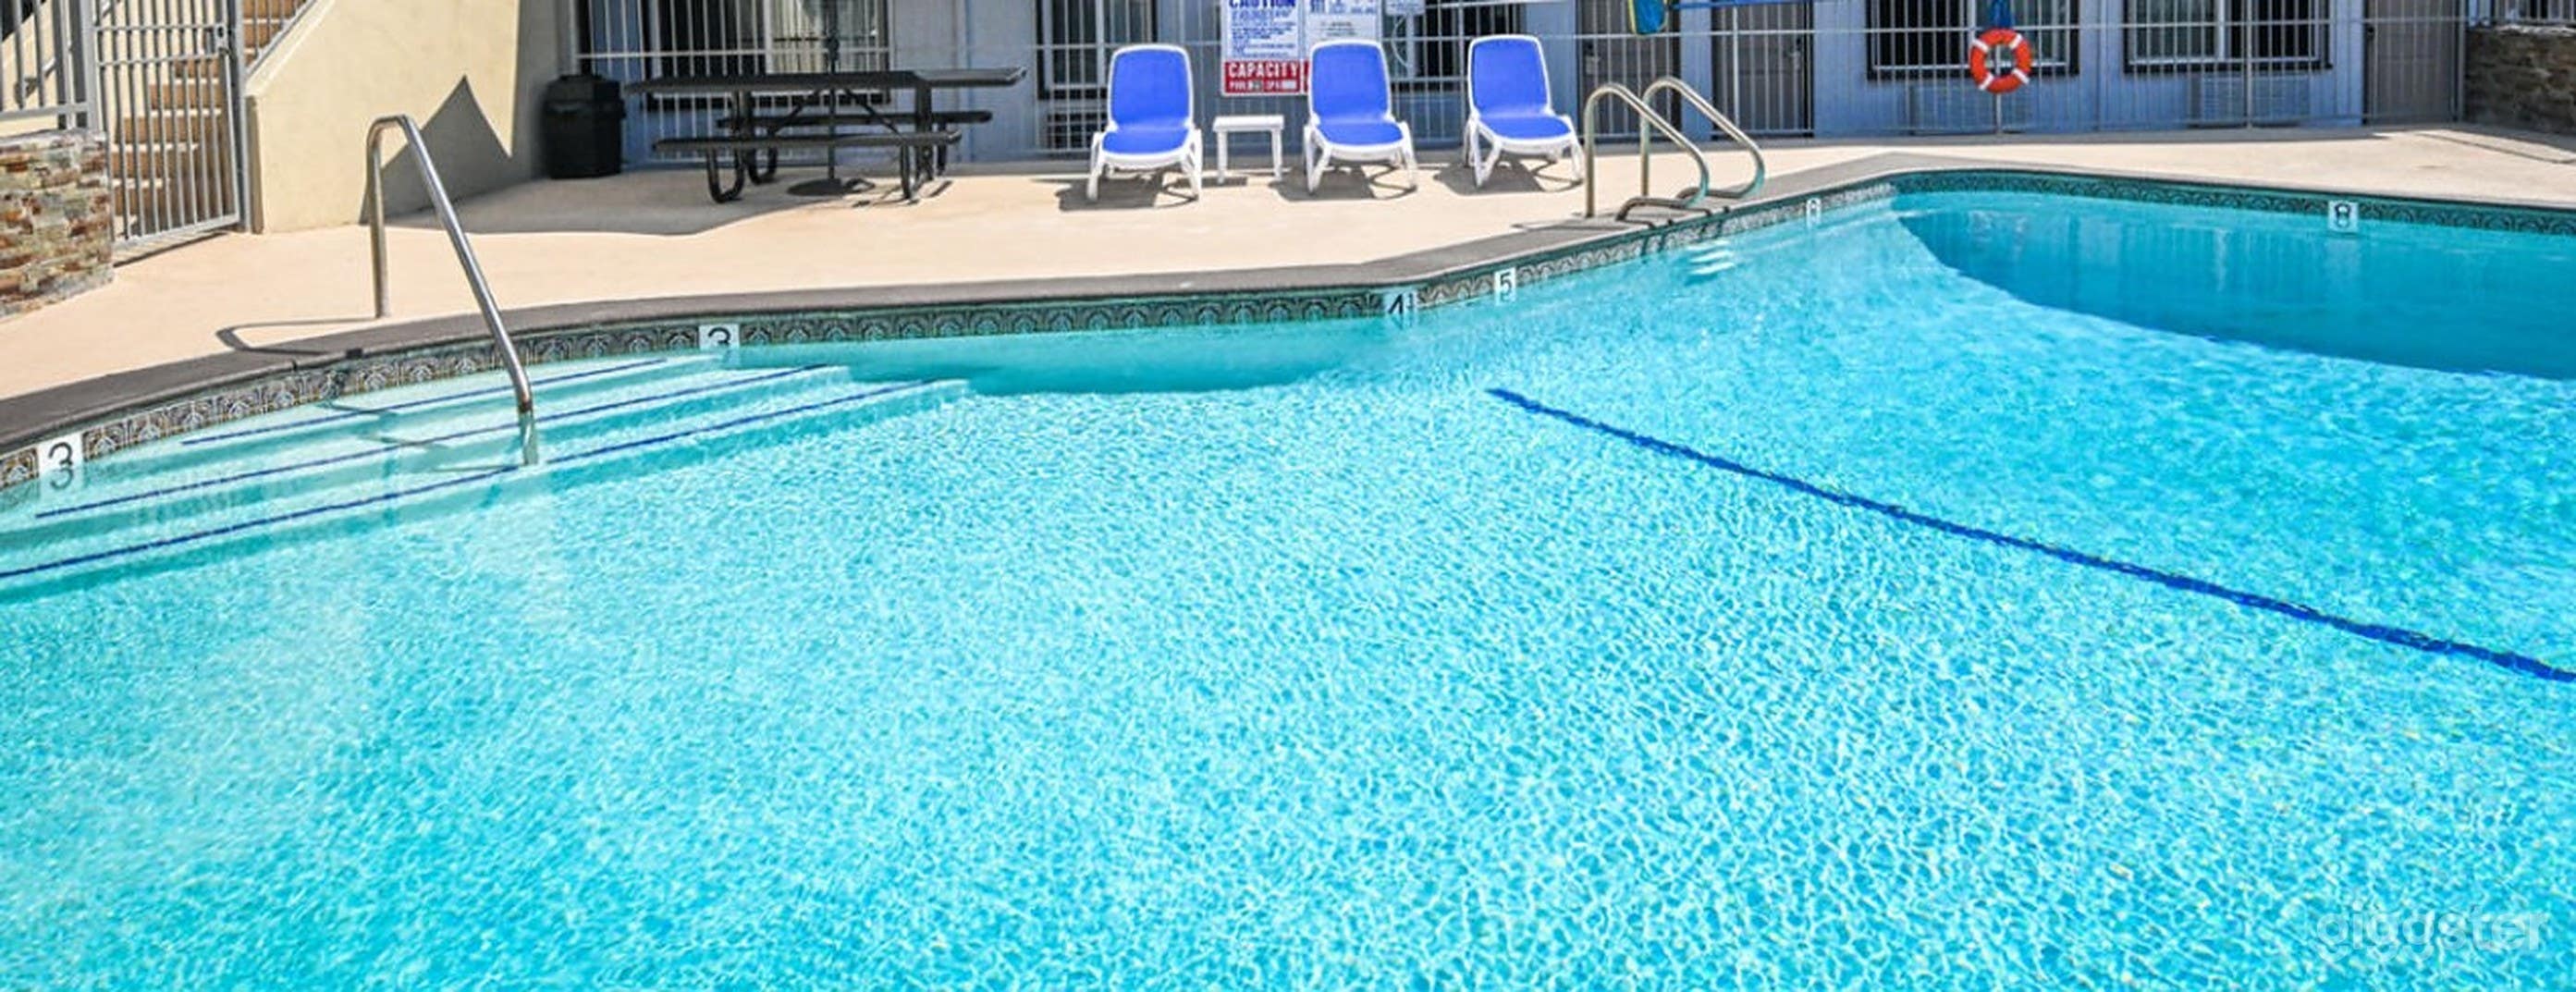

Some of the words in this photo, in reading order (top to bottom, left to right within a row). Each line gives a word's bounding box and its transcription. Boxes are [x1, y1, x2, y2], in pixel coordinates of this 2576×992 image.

[1228, 62, 1298, 78] CAPACITY
[1500, 272, 1513, 295] 5
[48, 441, 74, 489] 3
